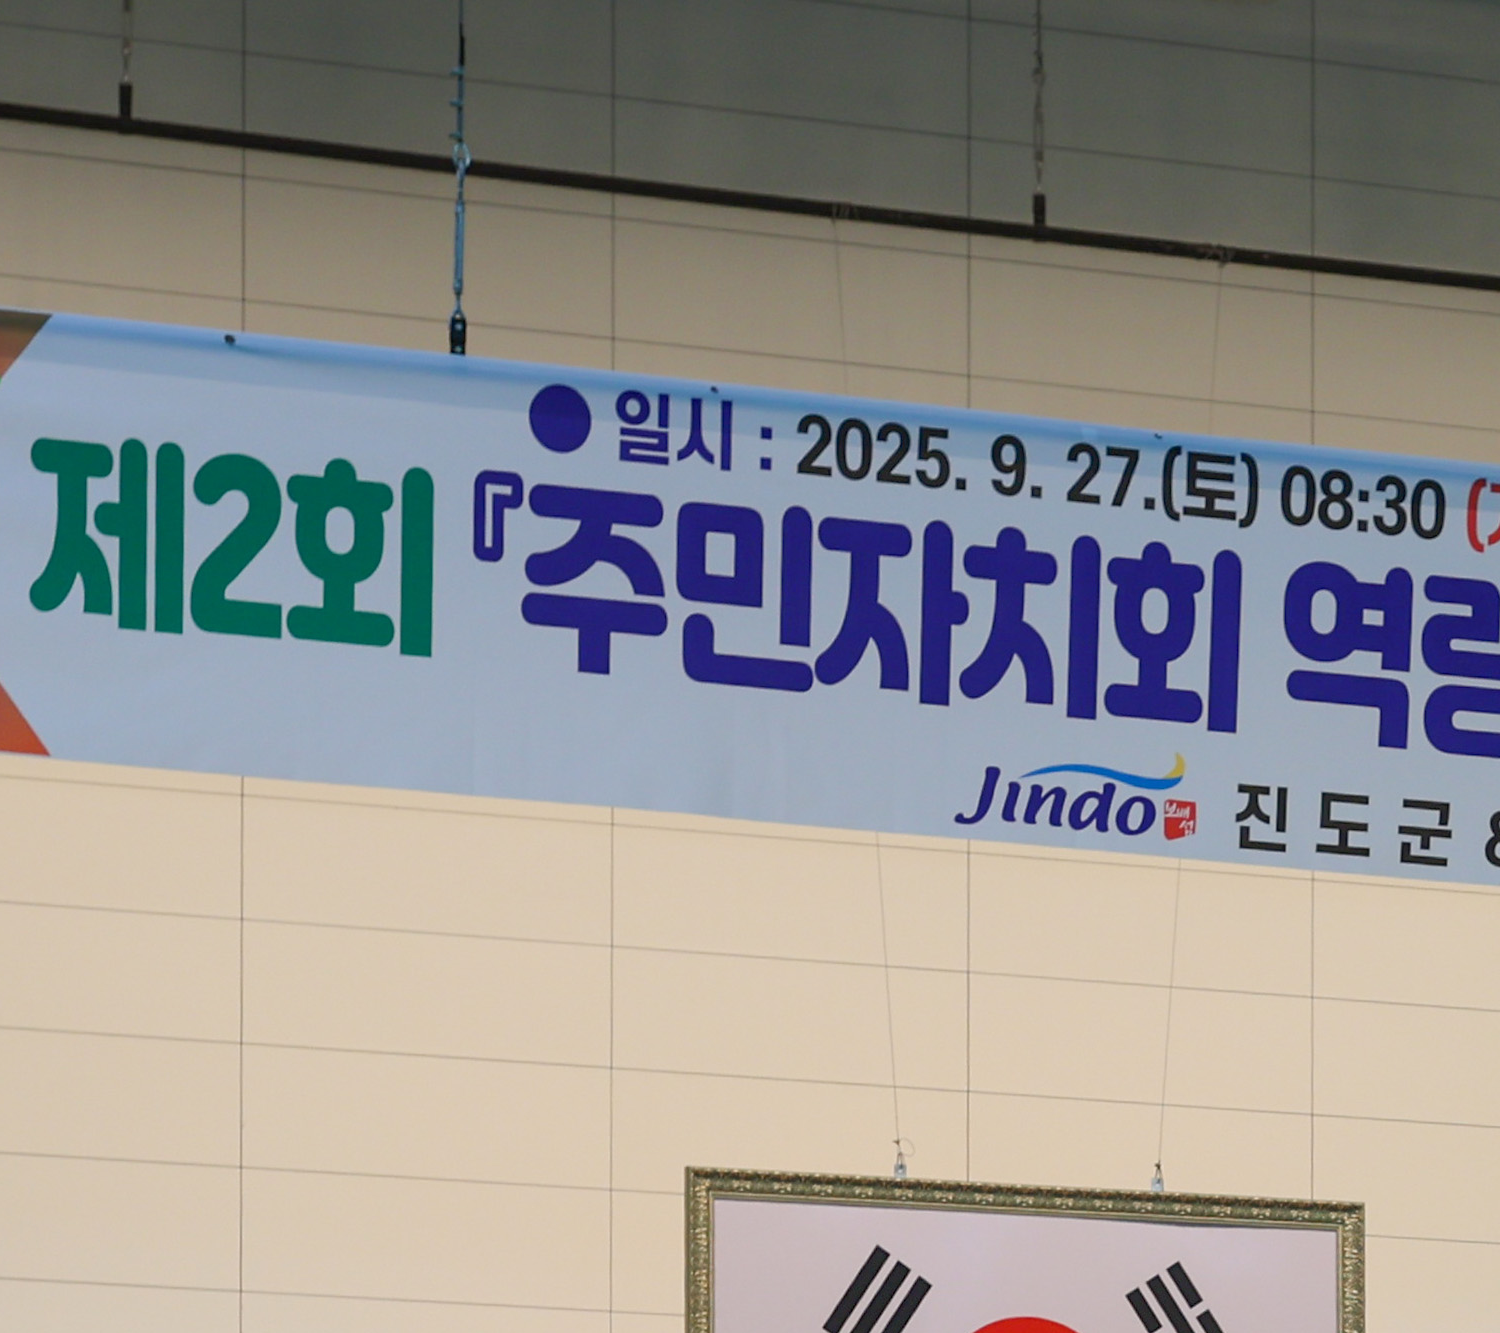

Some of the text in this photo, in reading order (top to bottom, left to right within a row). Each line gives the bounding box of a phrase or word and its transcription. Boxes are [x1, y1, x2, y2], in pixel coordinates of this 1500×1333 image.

[615, 388, 735, 472] 일시
[796, 413, 968, 491] 2025.
[991, 434, 1043, 499] 9.
[1066, 442, 1260, 529] 27.(토)
[1281, 463, 1446, 540] 08:30
[29, 437, 435, 658] 제2회
[473, 469, 1243, 734] 『주민자치회
[954, 766, 1157, 836] Jindo
